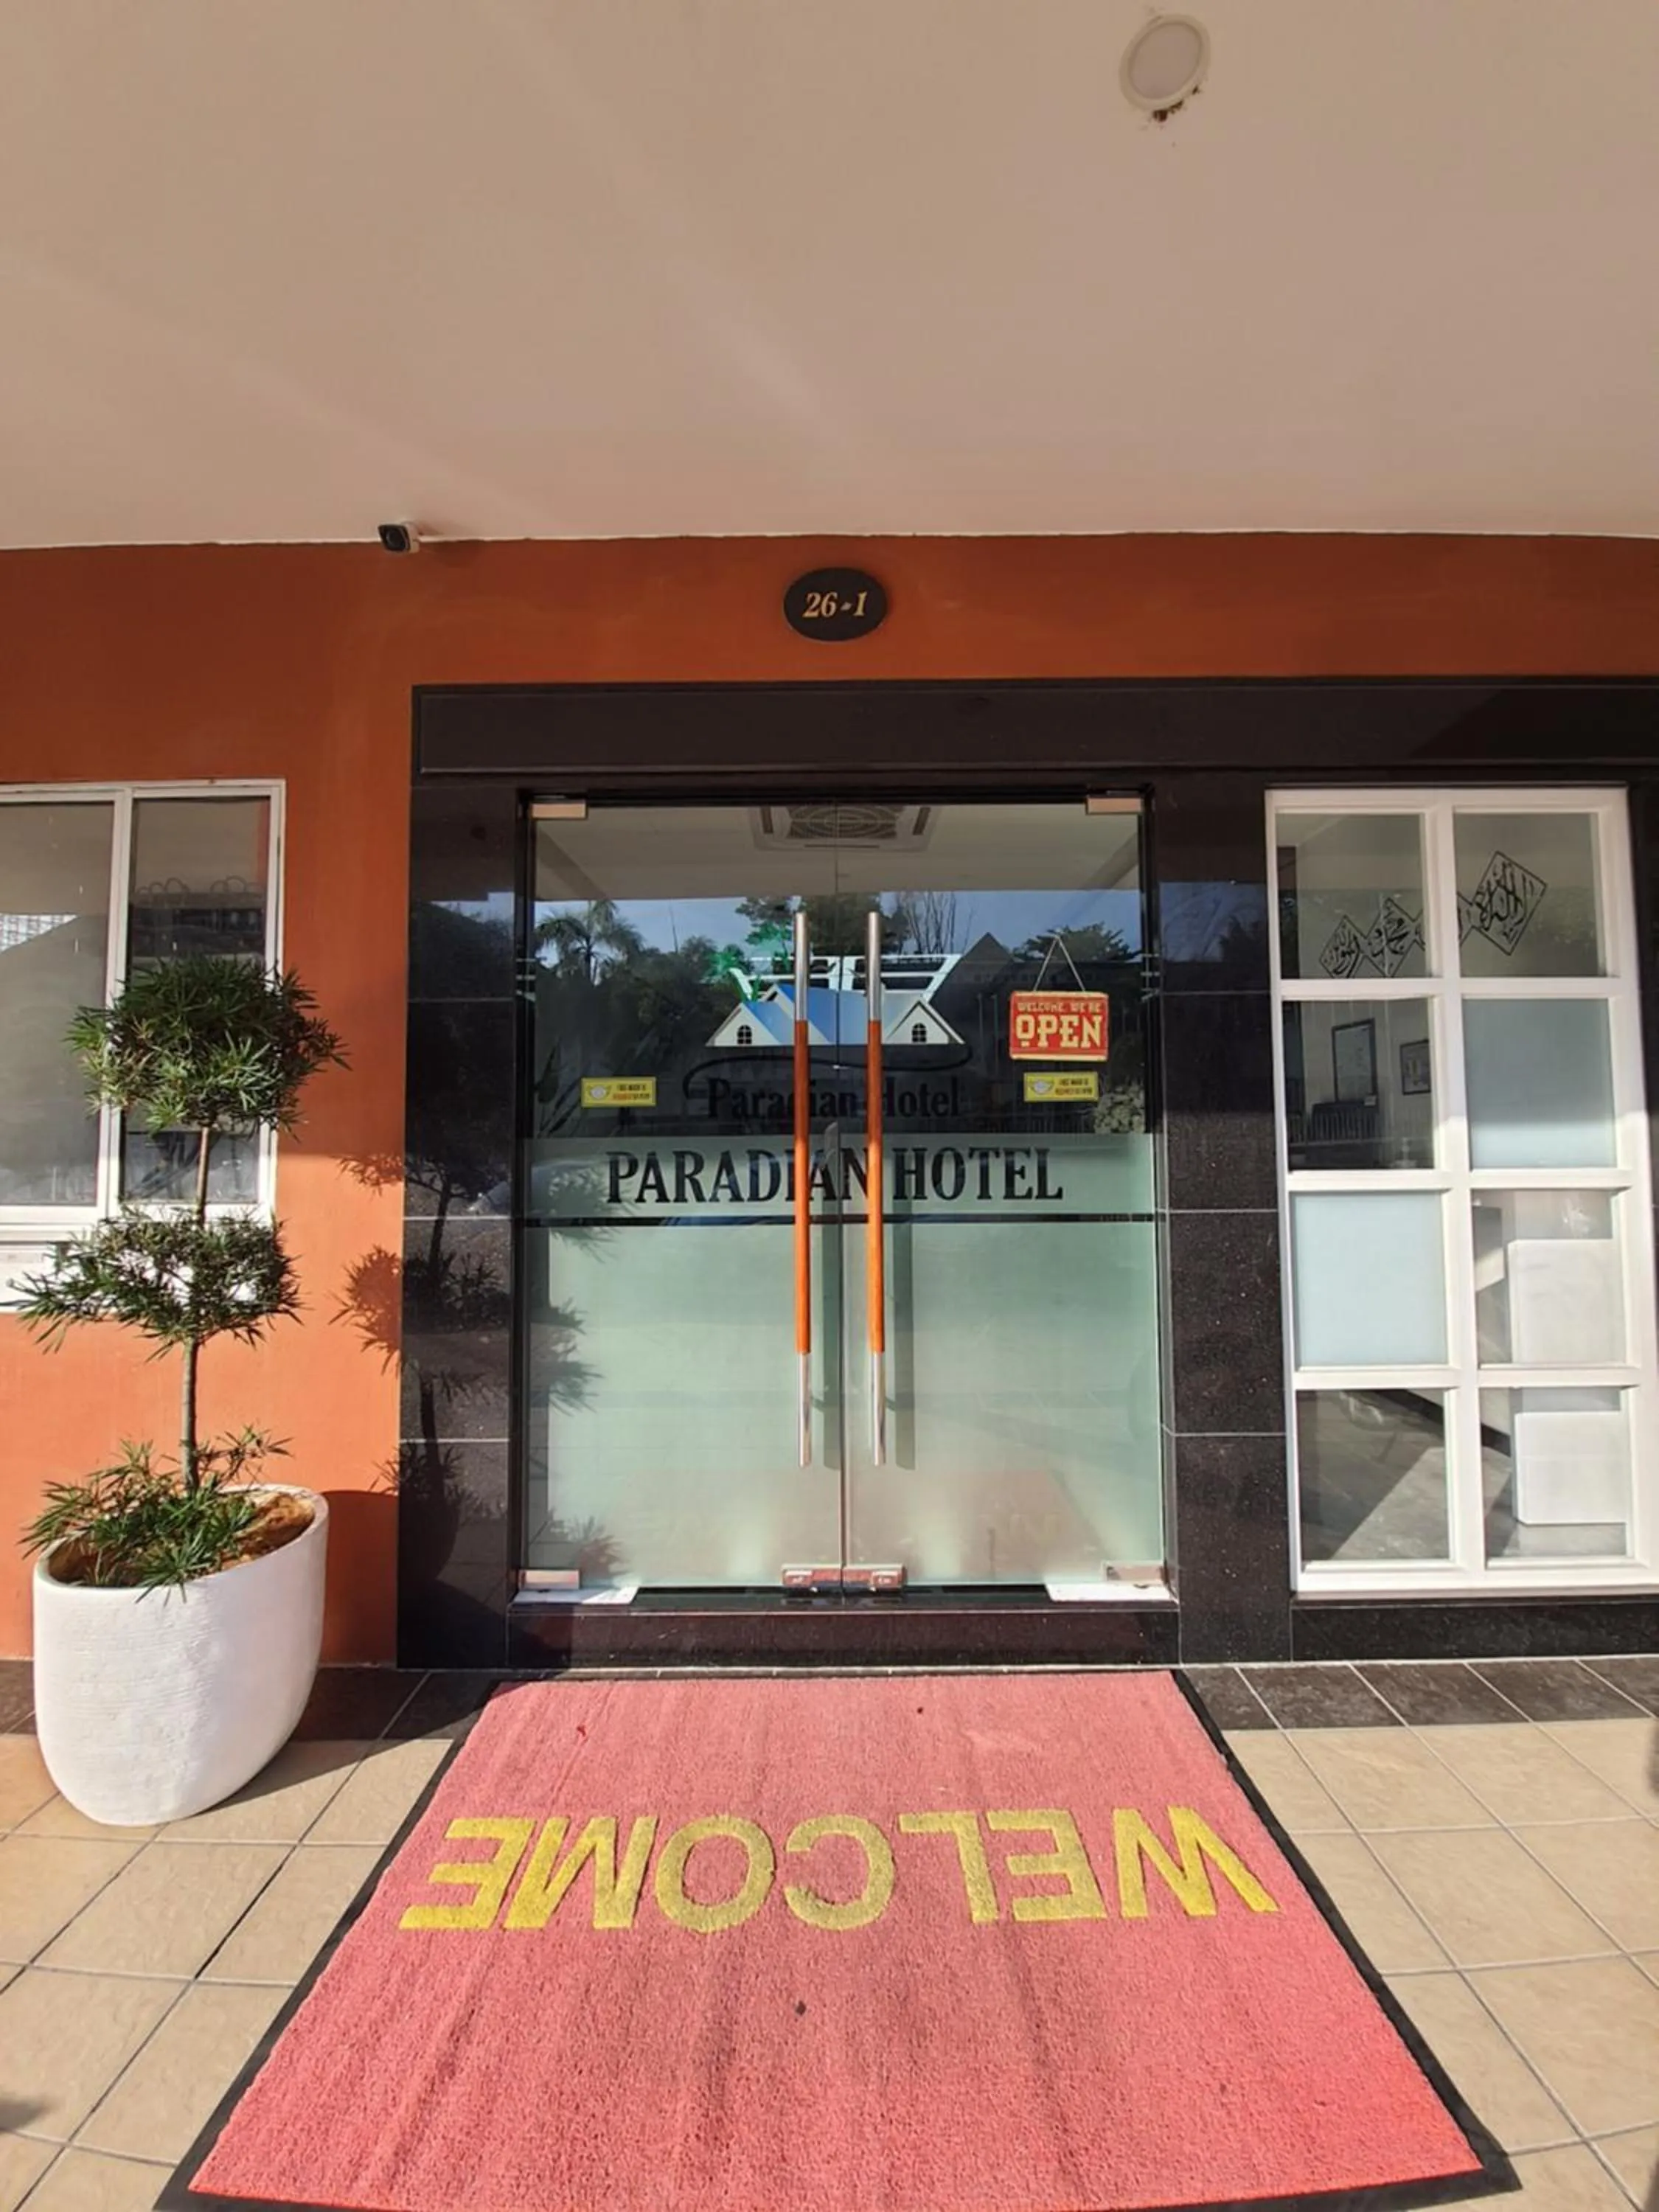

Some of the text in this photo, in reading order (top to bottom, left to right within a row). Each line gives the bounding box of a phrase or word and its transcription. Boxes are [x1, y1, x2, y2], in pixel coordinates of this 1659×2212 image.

[802, 591, 867, 618] 26-1
[1015, 1014, 1103, 1048] OPEN
[708, 1076, 858, 1119] Paraian
[891, 1147, 1063, 1200] HOTEL
[399, 1806, 1281, 1933] WELCOME
